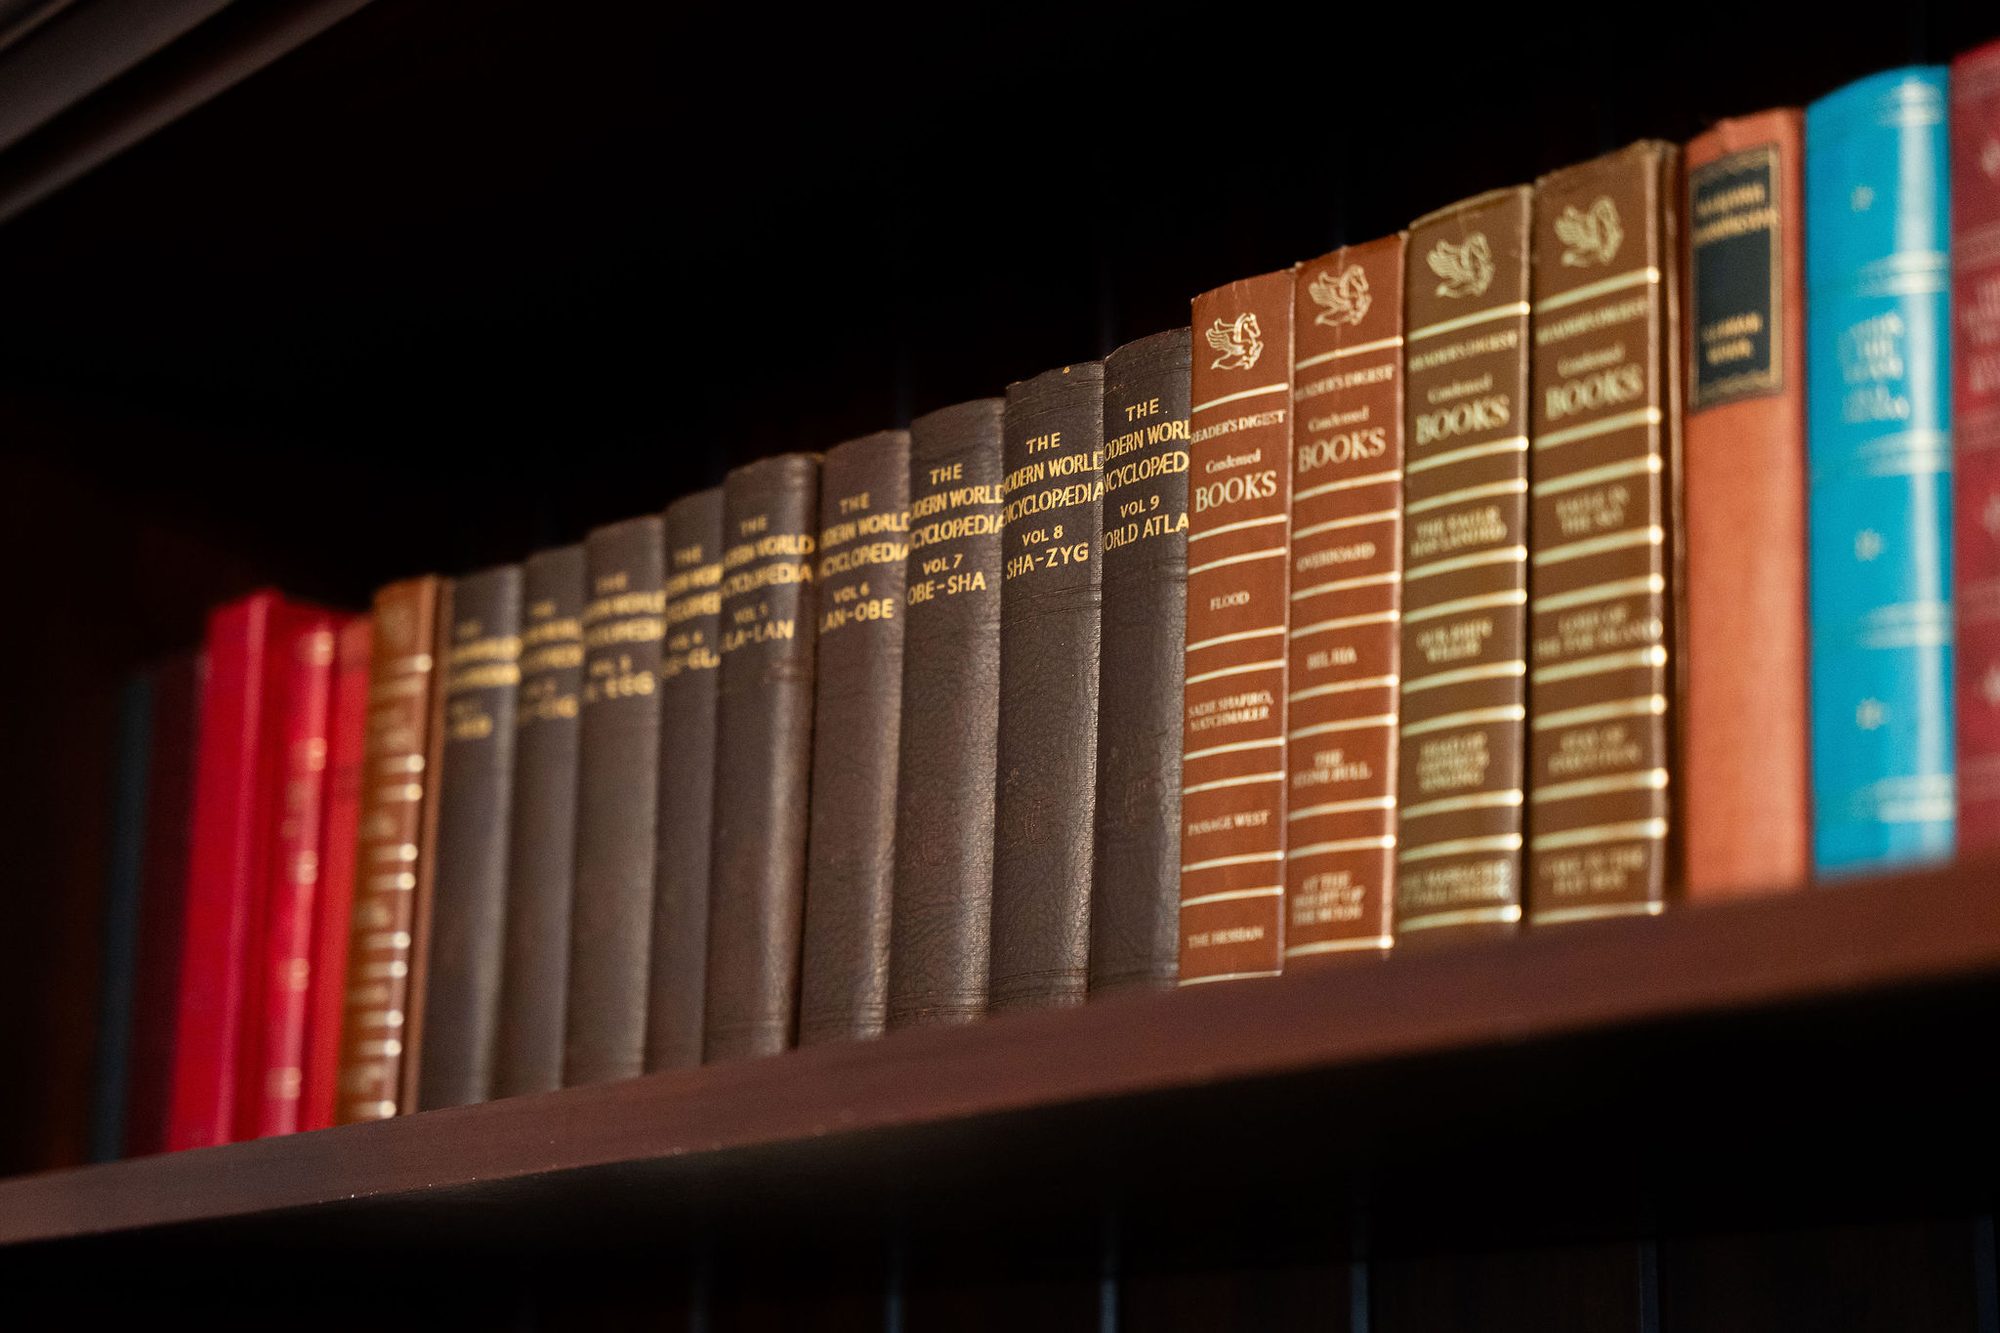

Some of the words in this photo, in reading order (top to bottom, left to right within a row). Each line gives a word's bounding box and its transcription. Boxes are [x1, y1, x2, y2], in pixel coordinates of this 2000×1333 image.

[1545, 363, 1643, 421] BOOKS
[1125, 398, 1159, 422] THE
[1416, 393, 1510, 445] BOOKS
[1191, 418, 1238, 445] READER'S
[1239, 409, 1286, 430] DIGEST
[1026, 432, 1061, 454] THE
[1104, 429, 1144, 461] ODERN
[1147, 420, 1191, 445] WORL
[1297, 426, 1386, 473] BOOKS
[1104, 451, 1189, 493] NCYCLOPÆD
[1206, 448, 1261, 474] Condensed
[930, 463, 963, 486] THE
[839, 492, 870, 513] THE
[1196, 470, 1277, 513] BOOKS
[1120, 499, 1146, 518] VOL
[1150, 495, 1160, 510] 9
[1022, 529, 1049, 546] VOL
[1053, 524, 1064, 539] 8
[1103, 523, 1139, 552] ORLD
[1143, 512, 1189, 538] ATLA
[755, 534, 815, 556] WORLD
[922, 557, 949, 576] VOL
[953, 554, 963, 569] 7
[1006, 542, 1089, 580] SHA-ZYG
[833, 585, 857, 604] VOL
[907, 571, 987, 606] OBE-SHA
[1210, 591, 1250, 611] FLOOD
[1234, 809, 1271, 829] WEST
